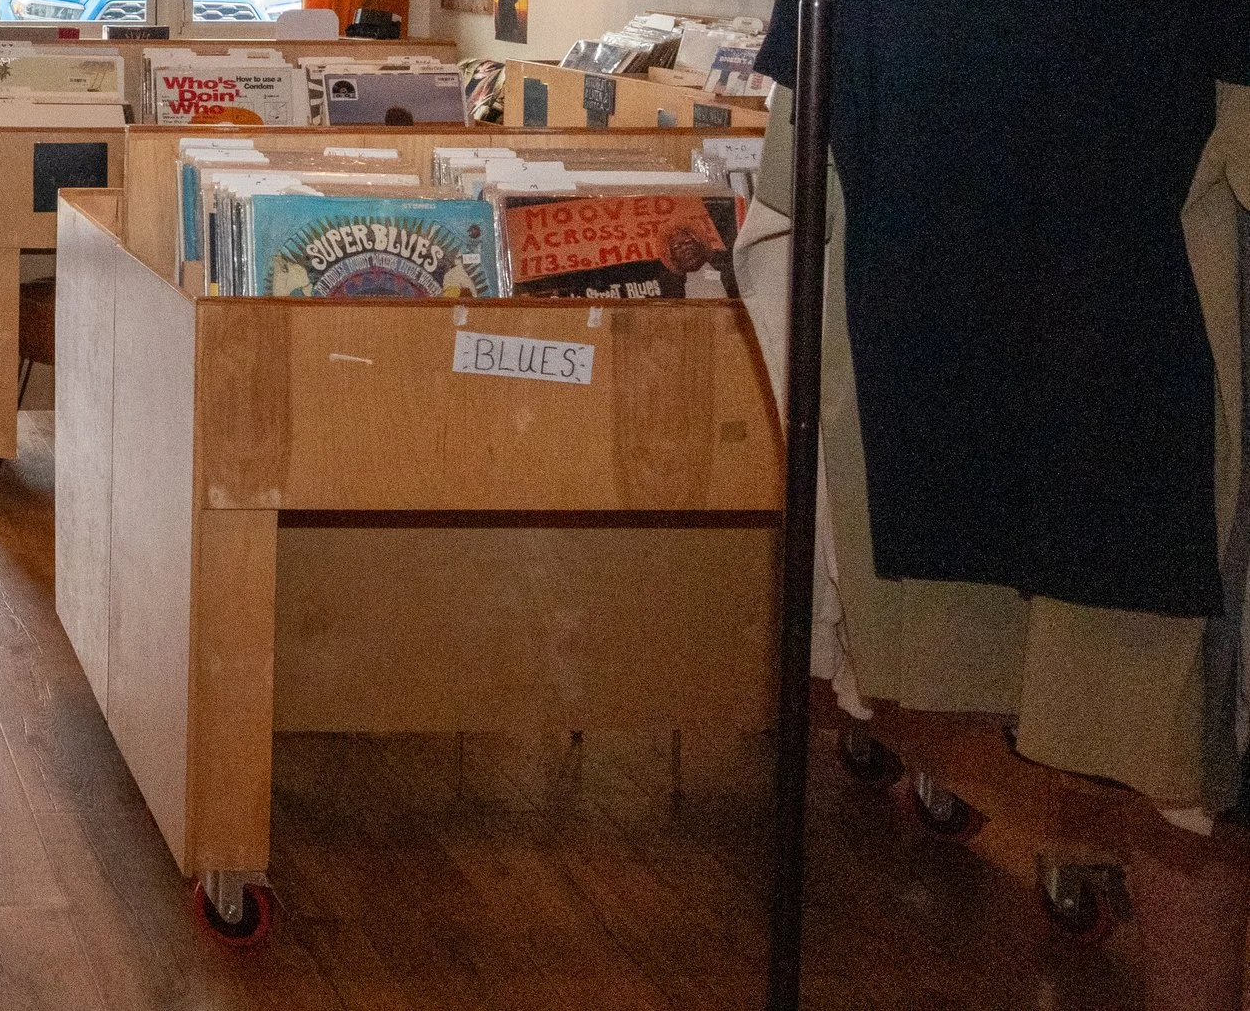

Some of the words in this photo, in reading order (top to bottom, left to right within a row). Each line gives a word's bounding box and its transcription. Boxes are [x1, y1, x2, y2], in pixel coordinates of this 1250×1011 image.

[163, 76, 237, 90] Who's
[178, 89, 243, 102] Doin'
[169, 100, 225, 115] Who
[525, 195, 676, 230] MOOVED
[306, 224, 373, 271] SUPER
[371, 223, 444, 273] BLUES
[474, 338, 577, 378] BLUES
